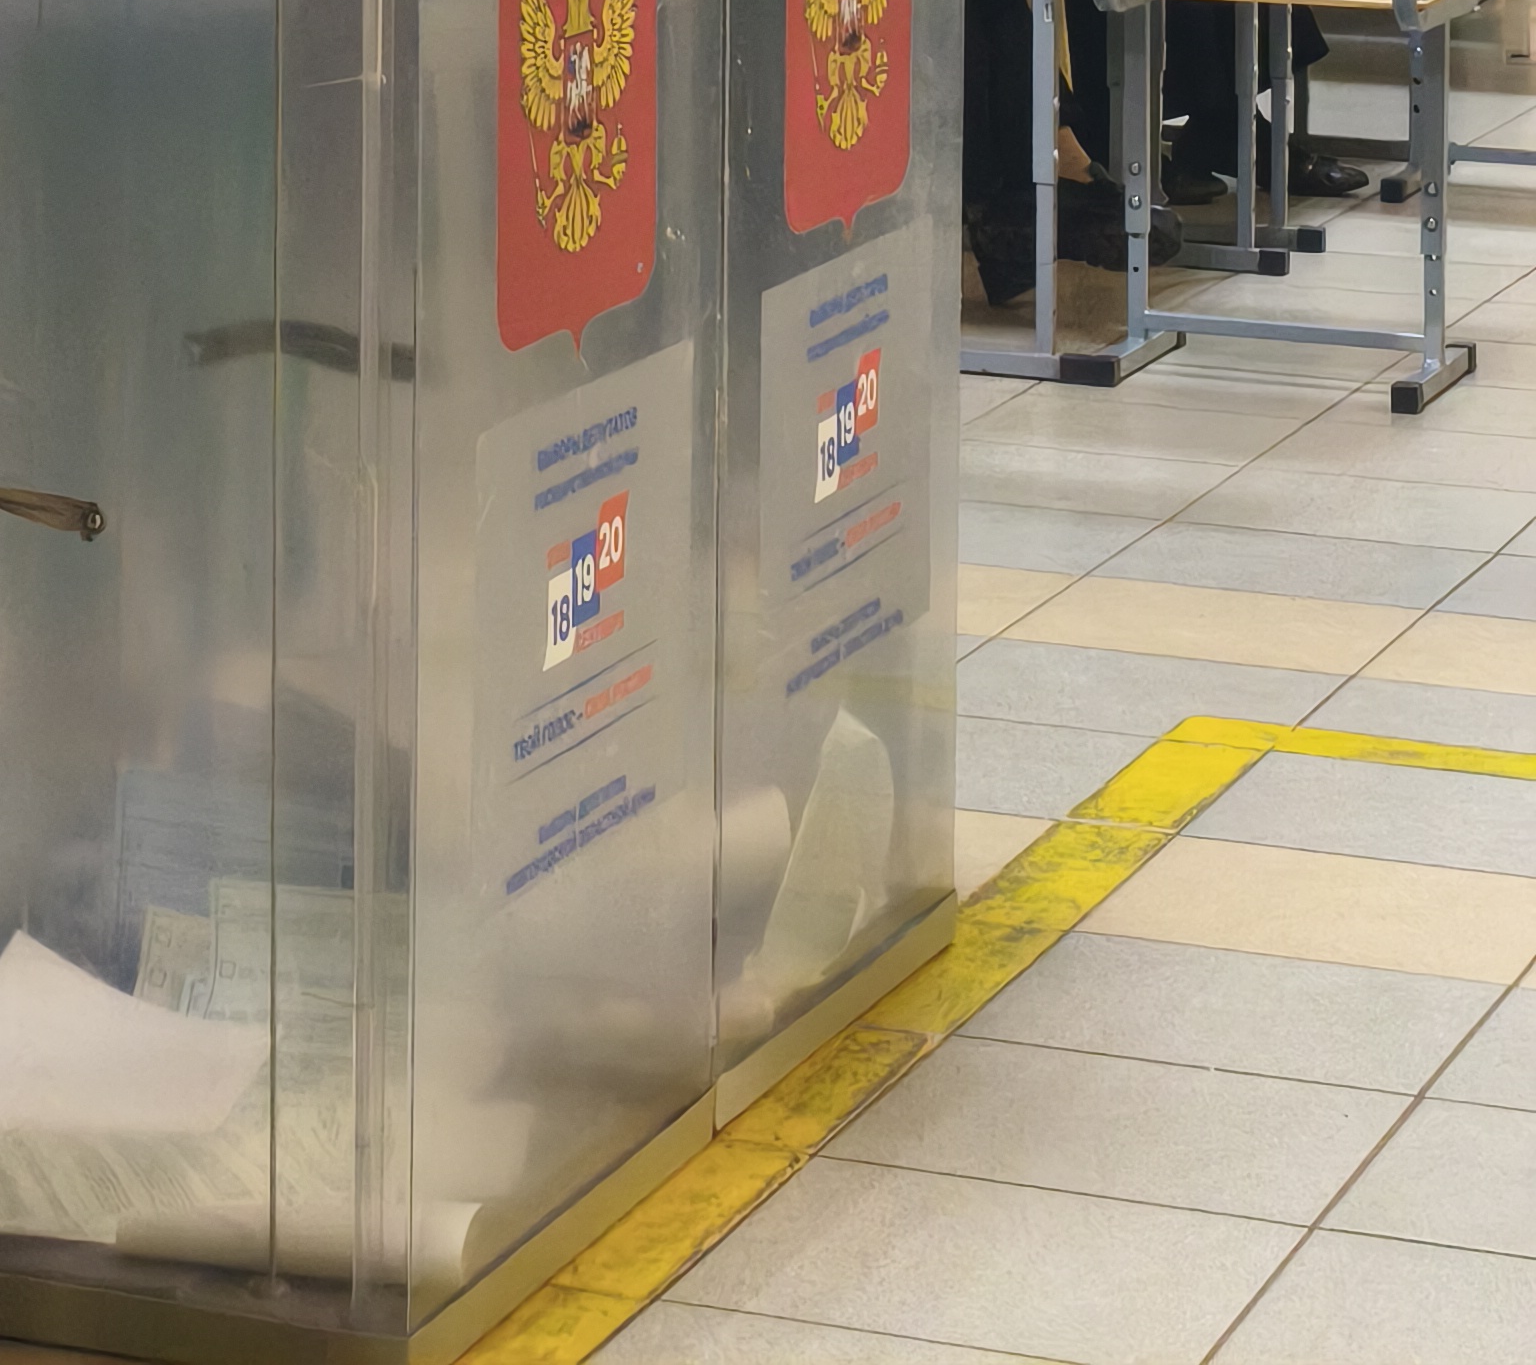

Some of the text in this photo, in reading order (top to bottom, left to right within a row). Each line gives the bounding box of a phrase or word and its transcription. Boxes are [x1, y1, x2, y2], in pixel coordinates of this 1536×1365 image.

[820, 369, 877, 481] 18 19 20
[551, 516, 623, 645] 18 19 20
